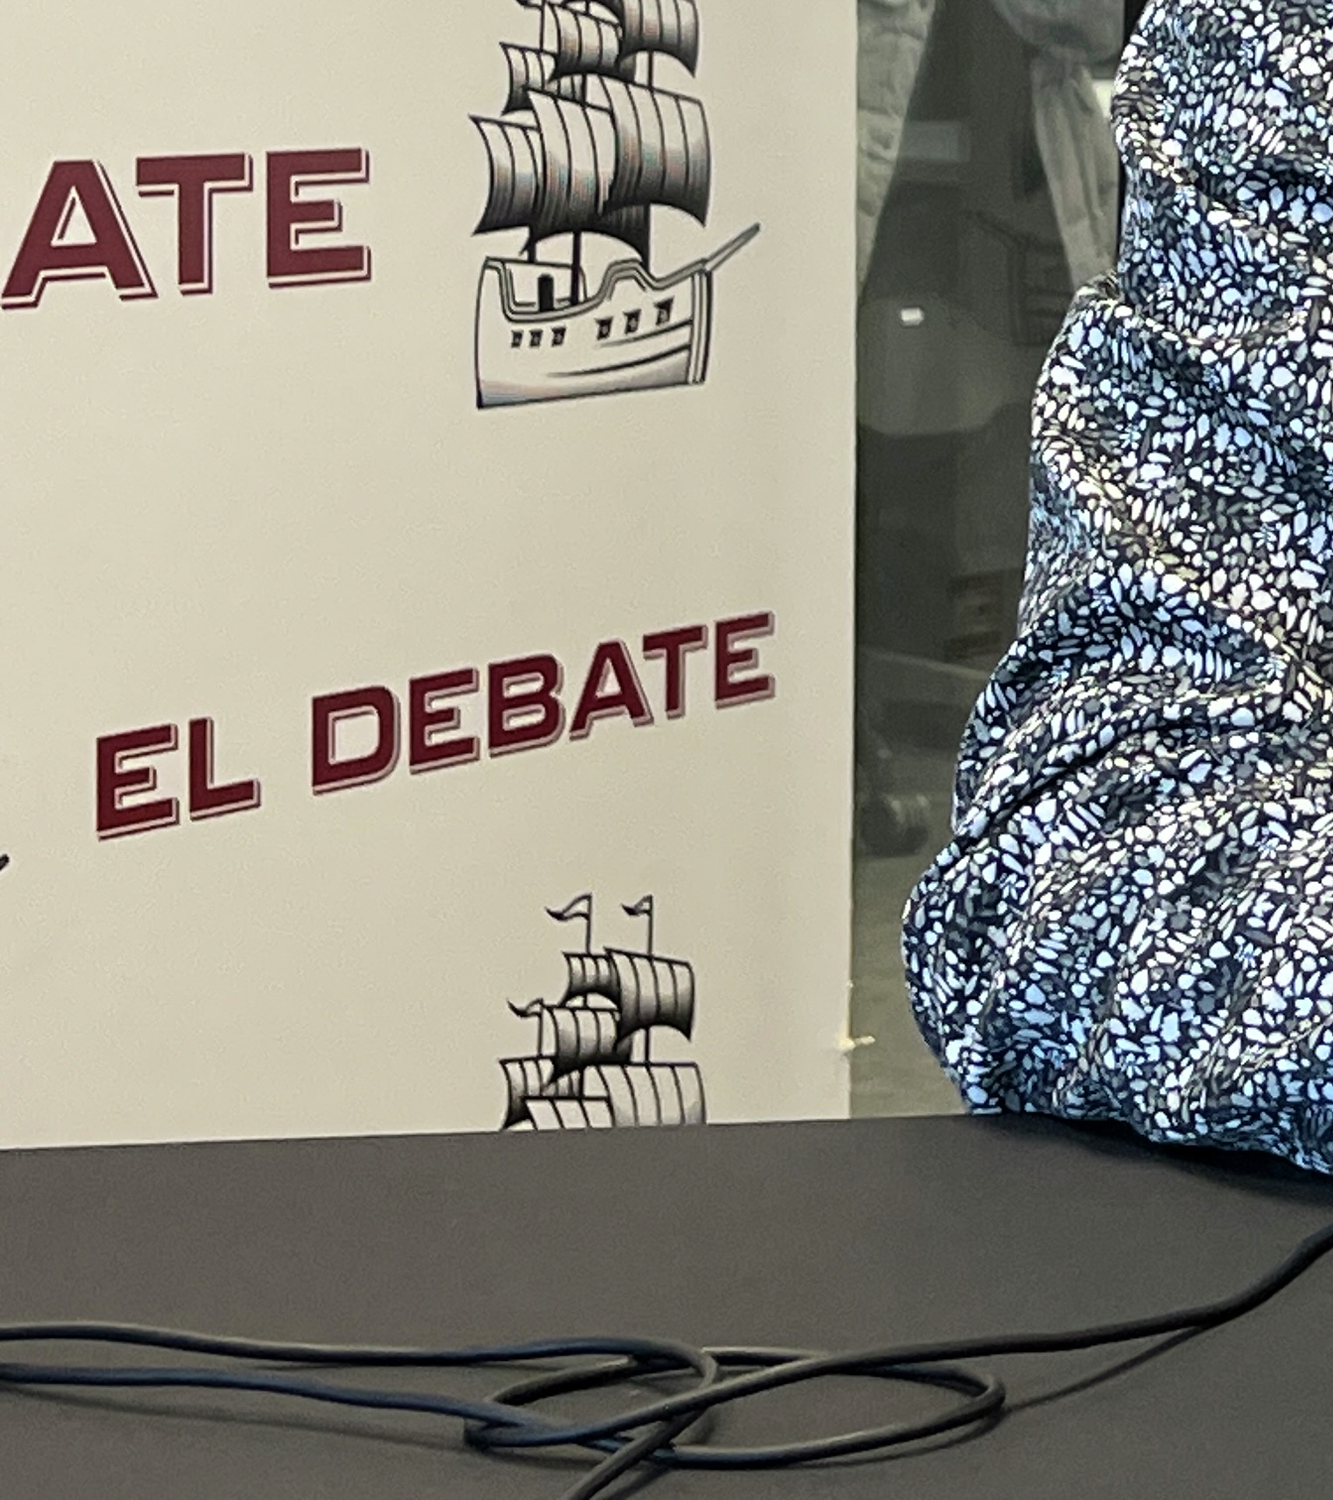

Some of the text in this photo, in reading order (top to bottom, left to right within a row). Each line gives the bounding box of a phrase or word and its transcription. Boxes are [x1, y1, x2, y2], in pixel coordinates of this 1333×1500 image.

[0, 148, 372, 310] ATE
[96, 610, 777, 842] EL DEBATE
